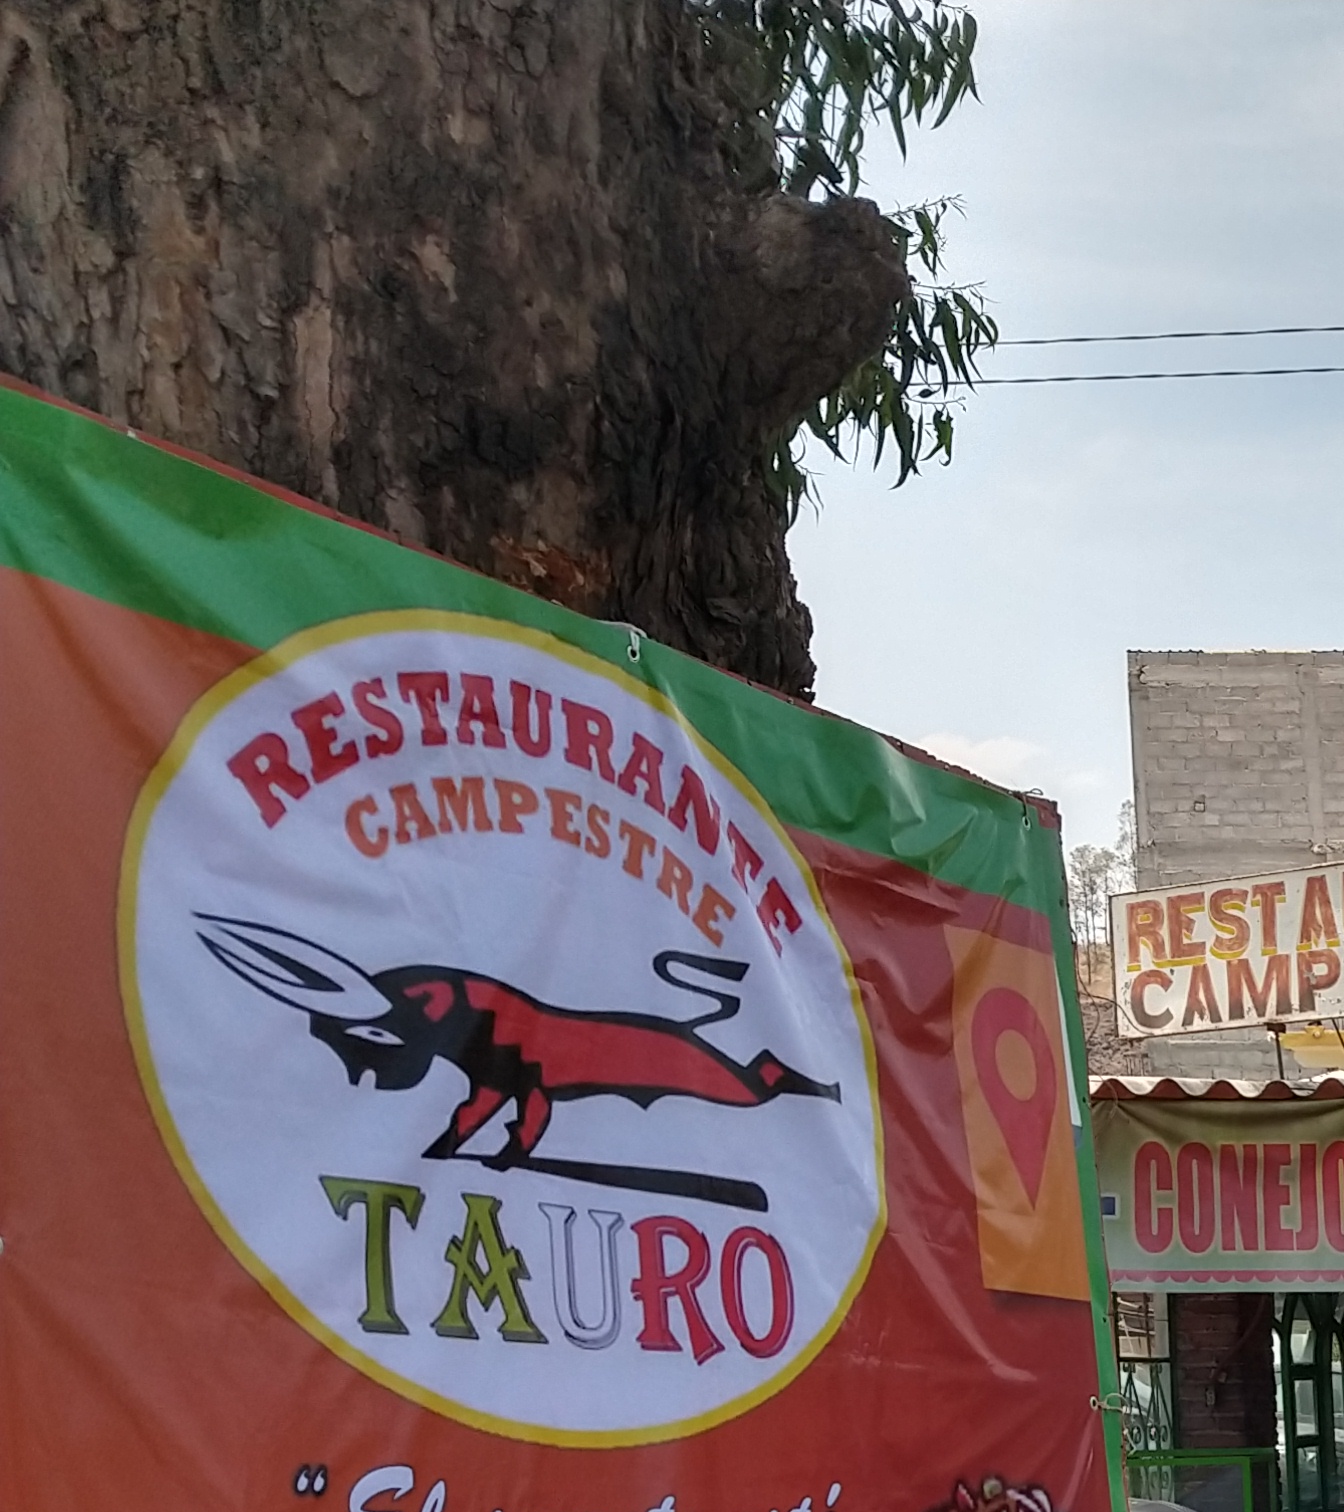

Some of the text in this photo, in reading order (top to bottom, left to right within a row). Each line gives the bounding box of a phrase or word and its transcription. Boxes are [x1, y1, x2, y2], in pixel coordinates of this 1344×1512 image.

[227, 672, 801, 958] RESTAURANTE
[345, 776, 736, 947] CAMPESTRE
[320, 1176, 796, 1367] TAURO
